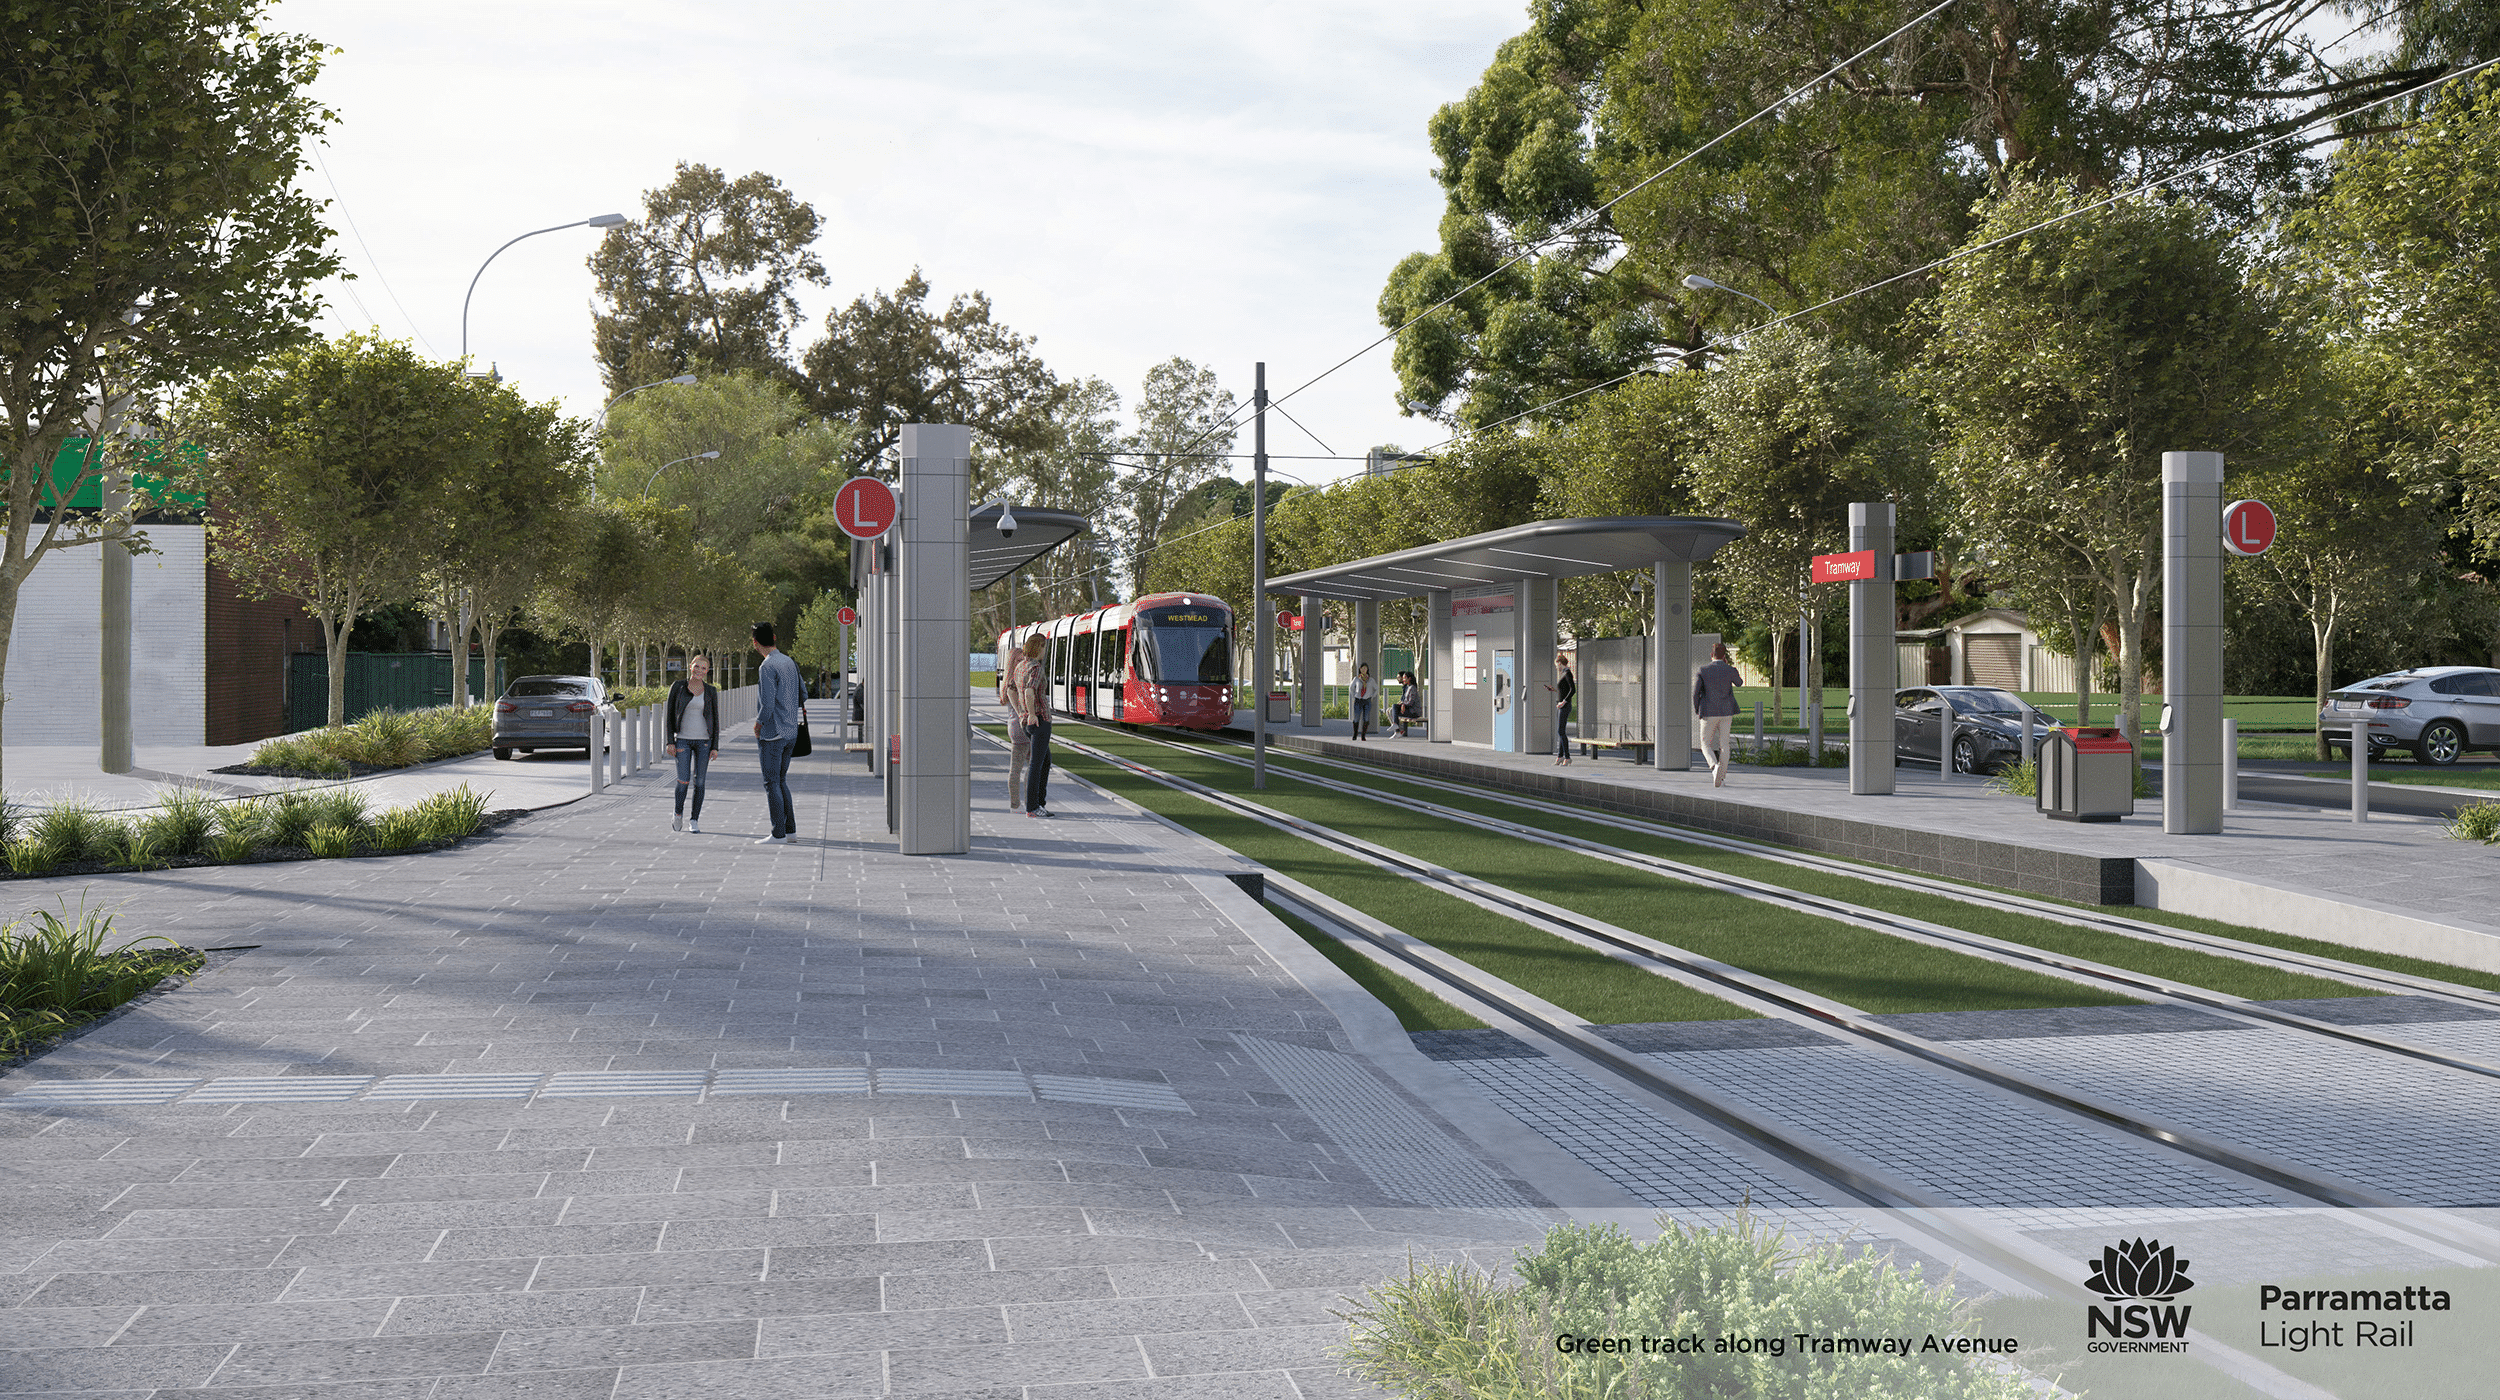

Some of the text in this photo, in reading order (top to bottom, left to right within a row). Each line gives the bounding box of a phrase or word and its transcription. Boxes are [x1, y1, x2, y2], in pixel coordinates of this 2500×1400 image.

[854, 489, 878, 527] L
[2241, 511, 2261, 545] L
[1824, 560, 1861, 577] Tramway
[1167, 614, 1208, 622] WESTMEAD
